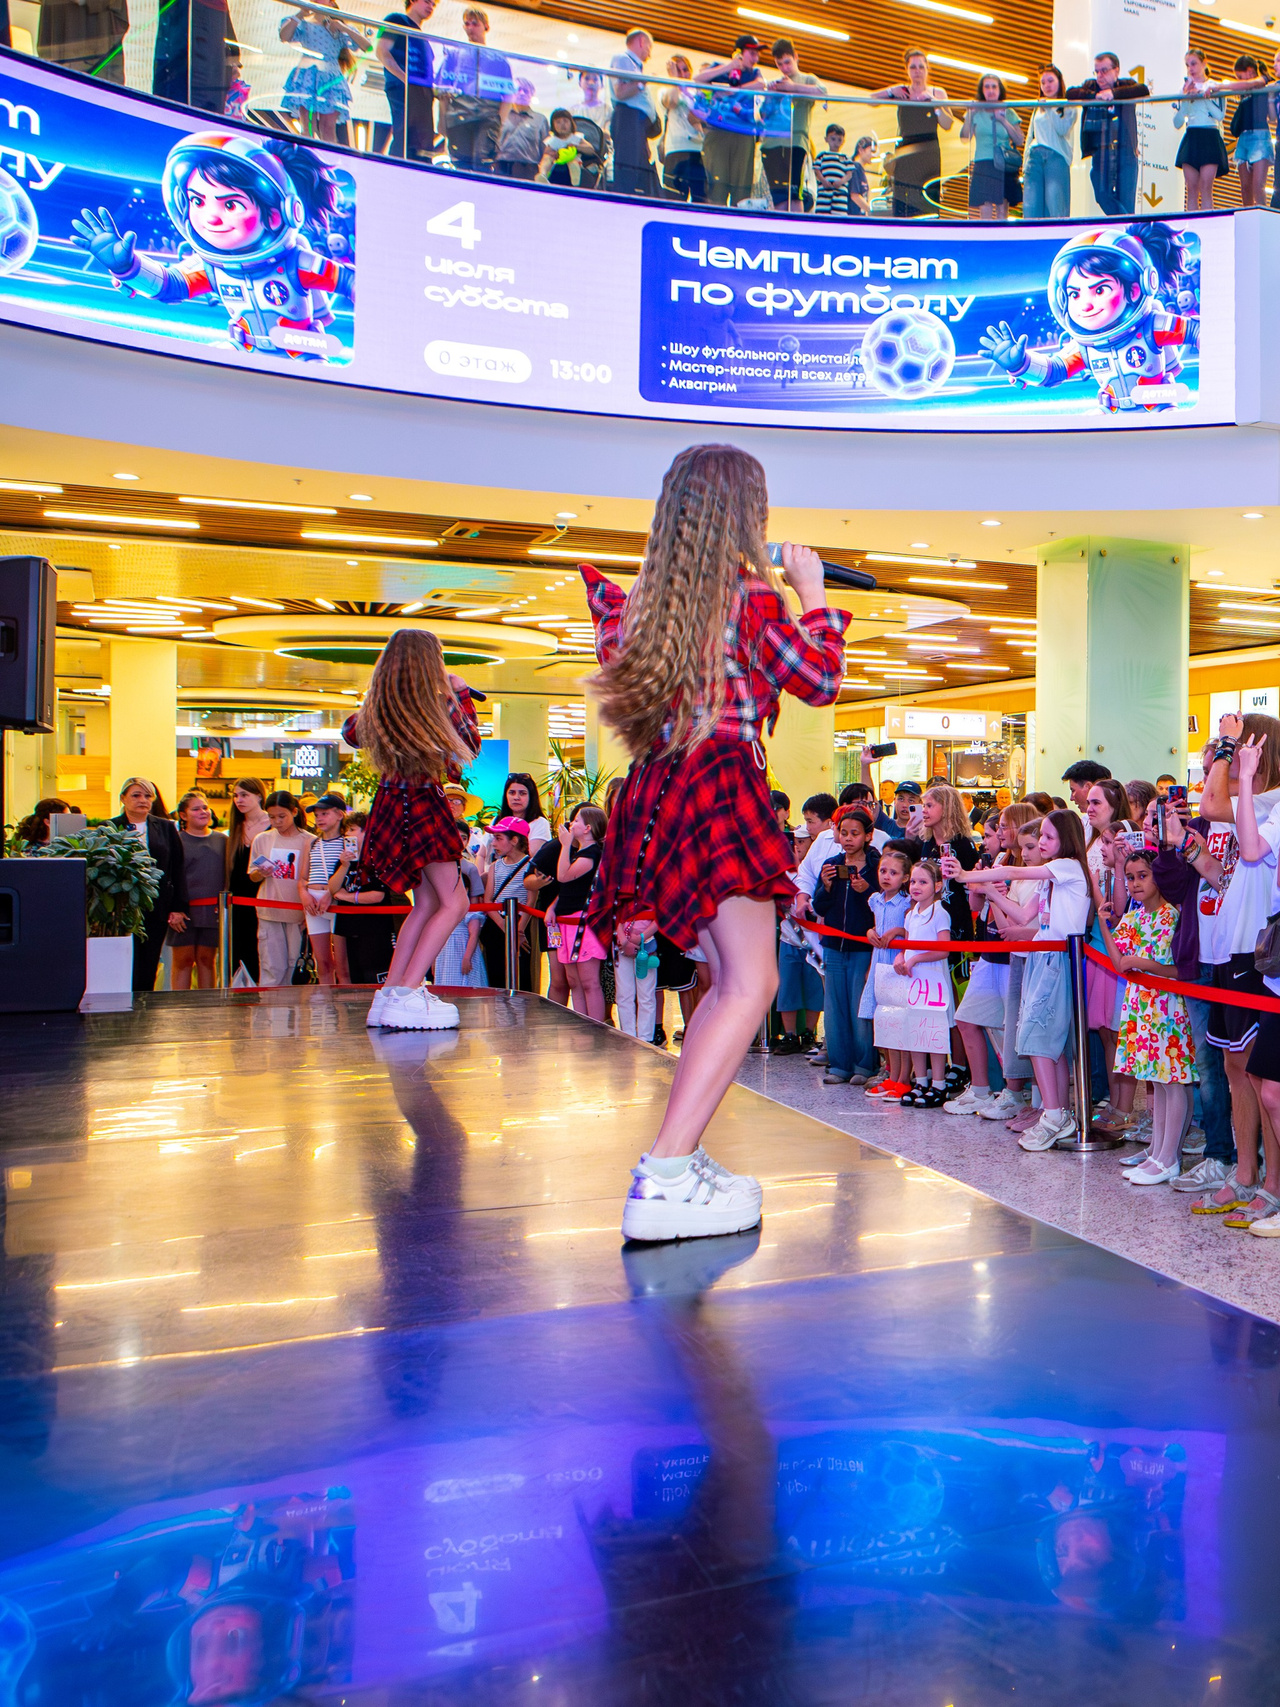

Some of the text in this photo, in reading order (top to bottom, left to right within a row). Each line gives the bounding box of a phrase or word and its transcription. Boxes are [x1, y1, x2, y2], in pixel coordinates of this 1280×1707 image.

[426, 200, 482, 250] 4
[424, 255, 515, 284] июля
[671, 236, 959, 280] Чемпионат
[423, 284, 570, 319] суббота
[670, 279, 977, 322] по футболу
[438, 350, 517, 374] 0 этаж
[669, 341, 700, 357] Шоу
[702, 344, 790, 363] футбольного
[549, 358, 613, 384] 13:00
[668, 359, 772, 379] Мастер-класс
[774, 367, 799, 380] для
[801, 369, 833, 382] всех
[668, 377, 738, 394] Аквагрим
[941, 715, 951, 730] 0
[290, 764, 325, 777] ЛИФТ
